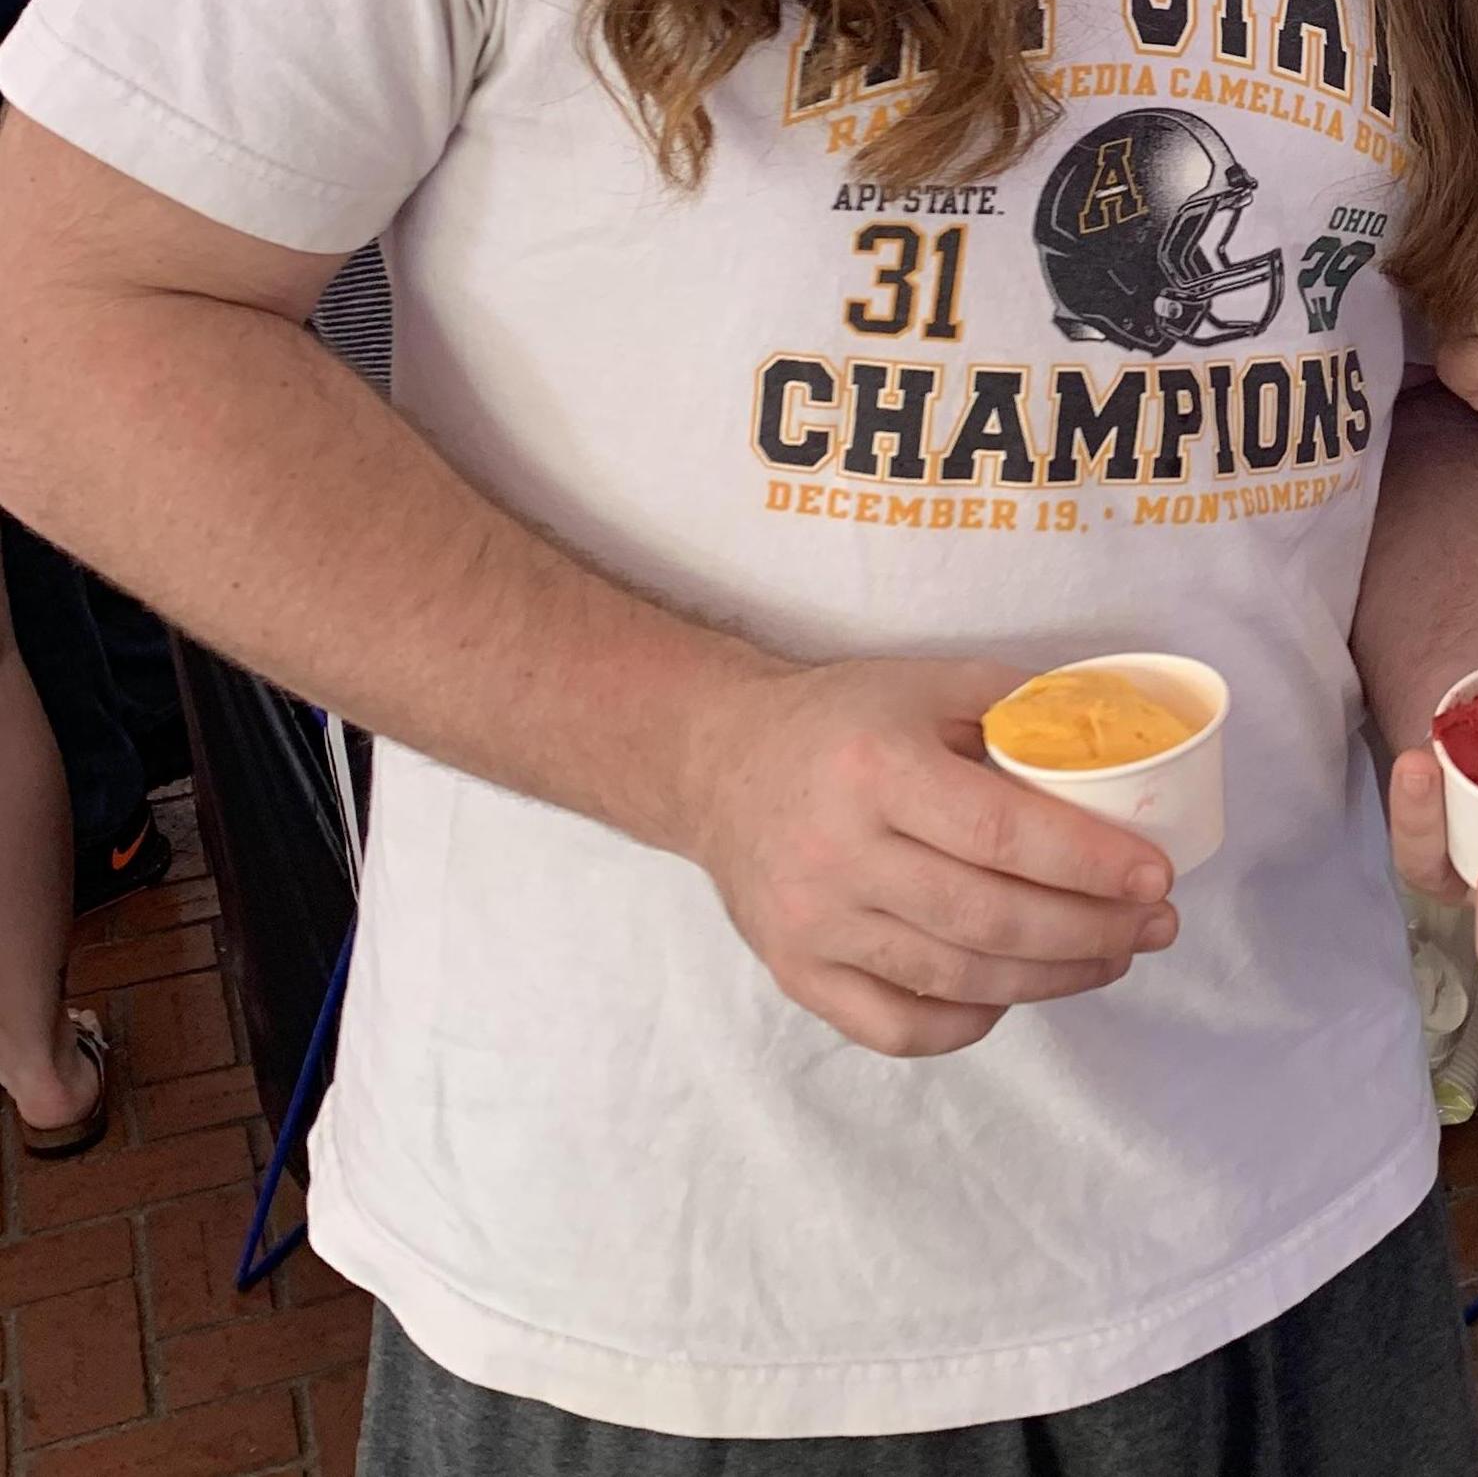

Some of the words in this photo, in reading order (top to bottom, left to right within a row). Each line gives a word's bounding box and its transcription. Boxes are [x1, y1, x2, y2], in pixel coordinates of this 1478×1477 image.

[1170, 68, 1345, 142] CAMELLIA
[843, 224, 970, 342] 31
[750, 348, 1372, 489] CHAMPIONS
[764, 479, 1018, 531] DECEMBER
